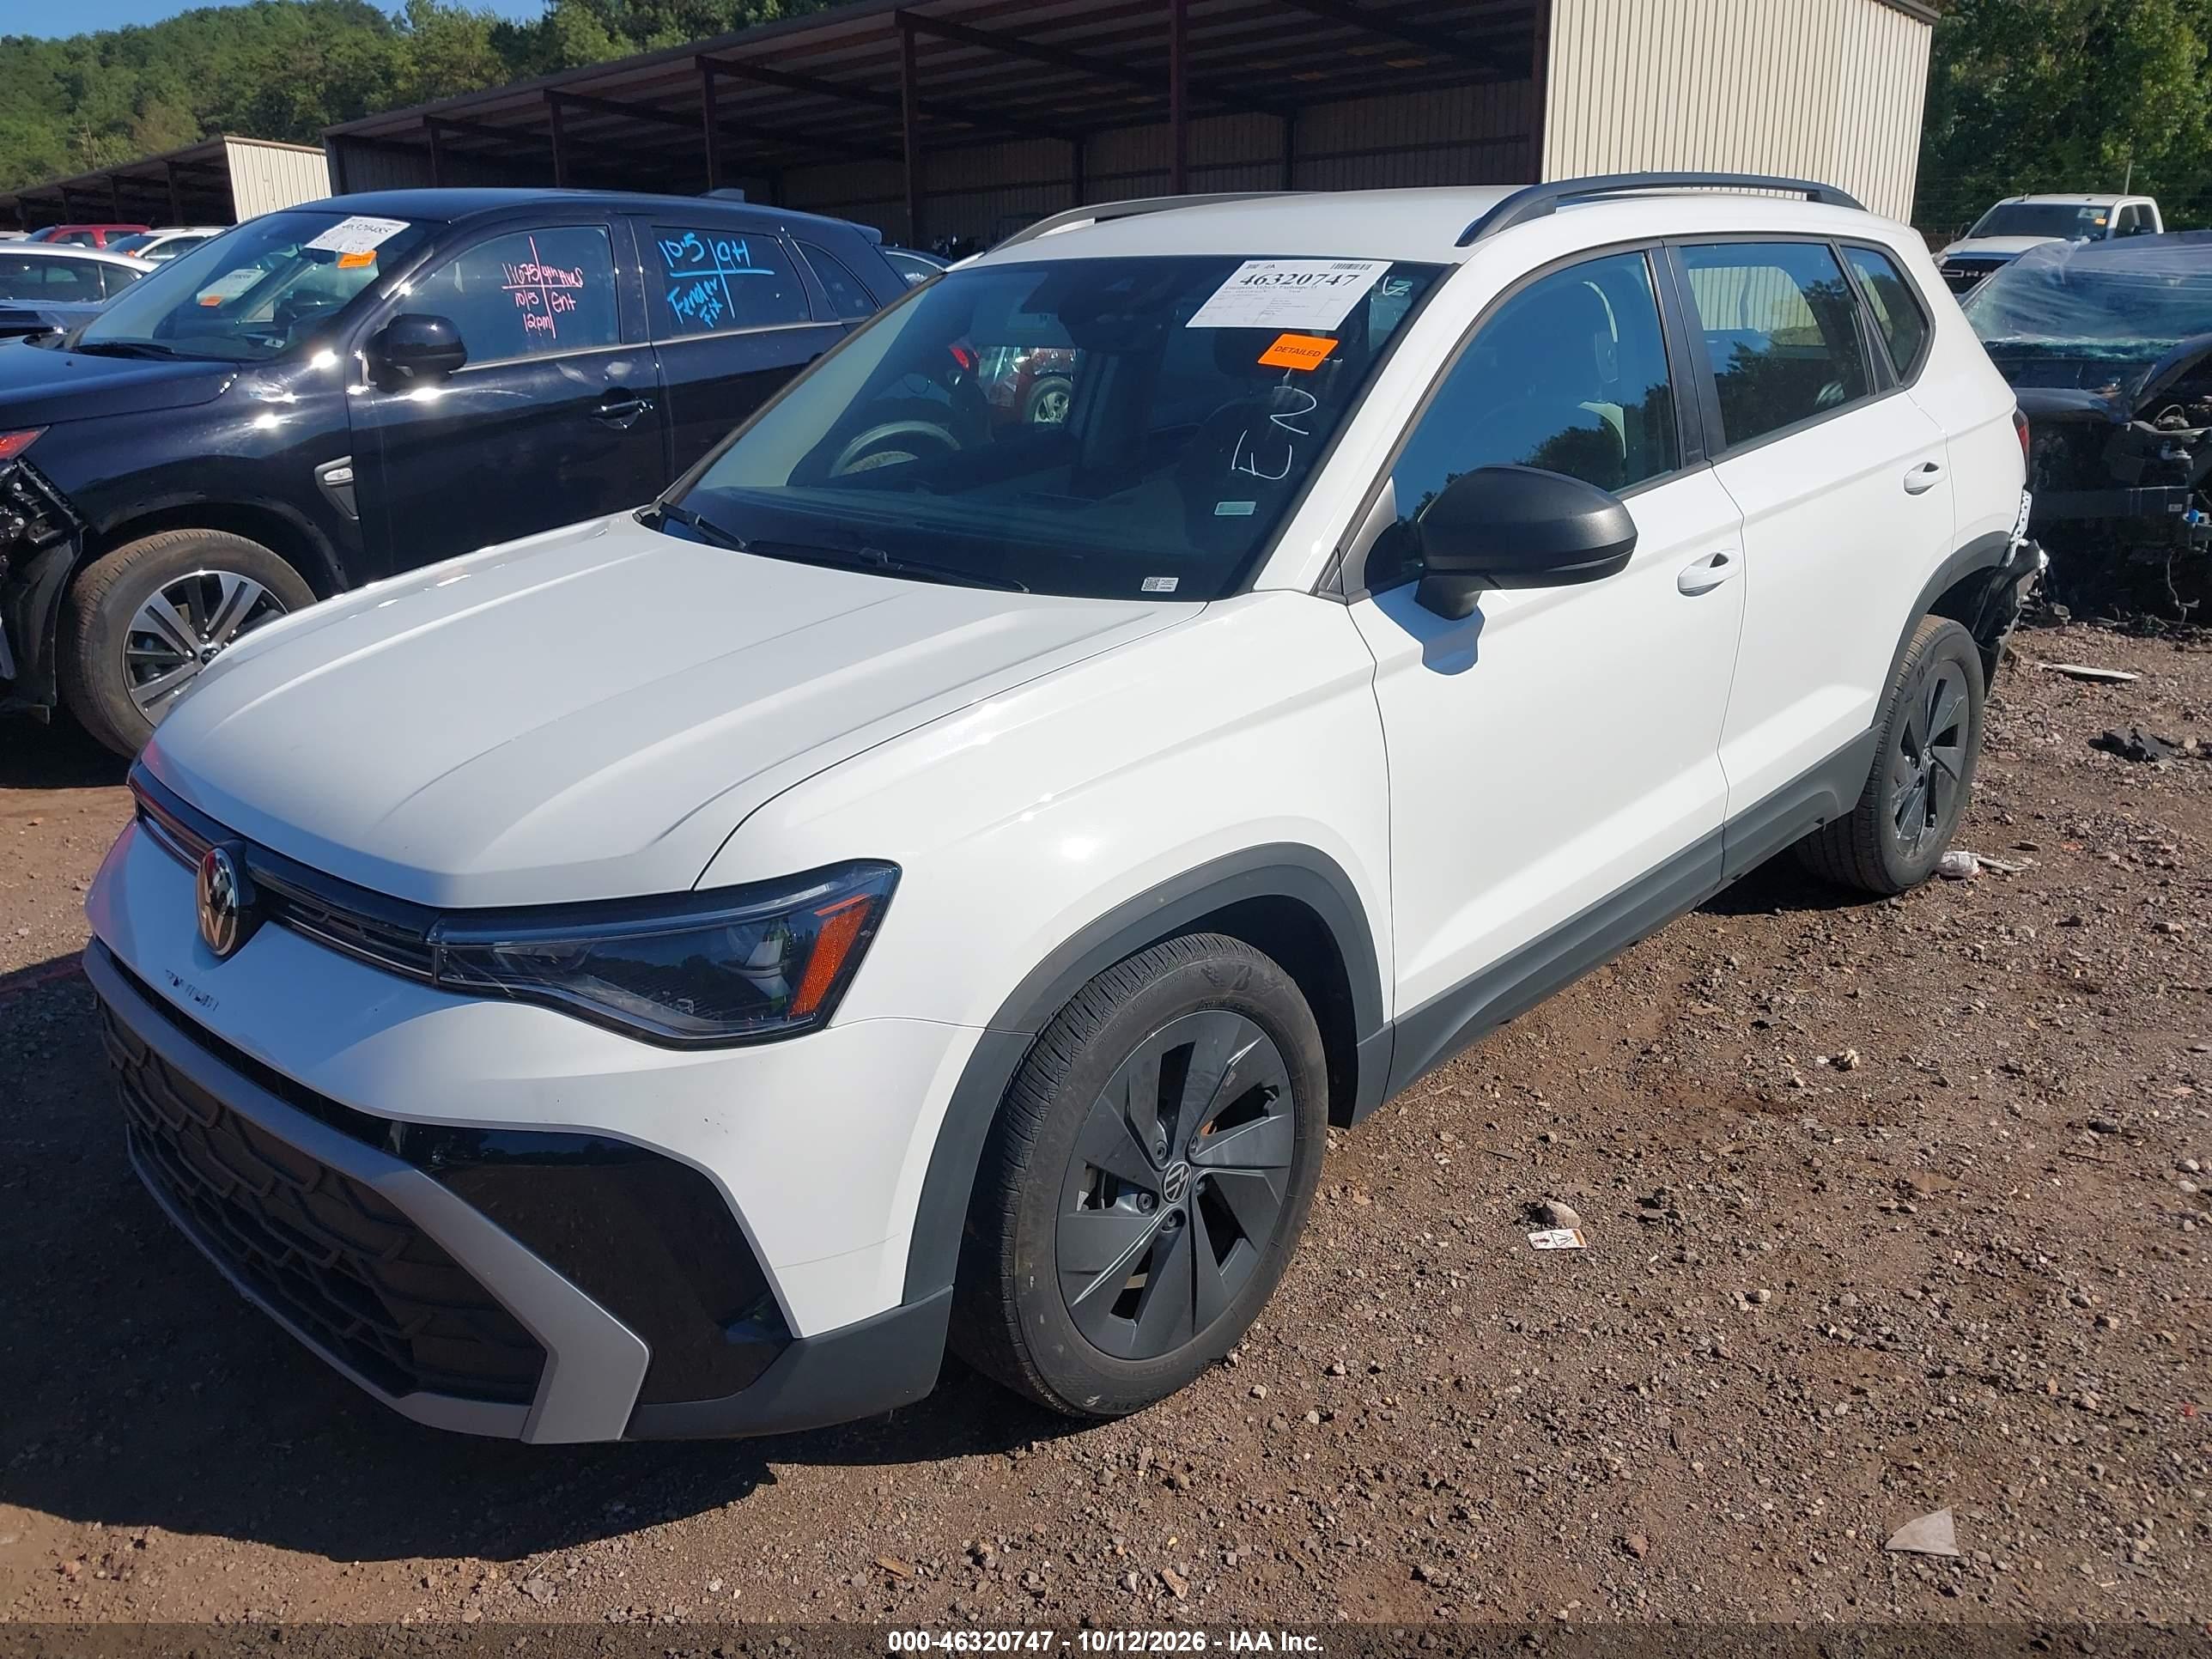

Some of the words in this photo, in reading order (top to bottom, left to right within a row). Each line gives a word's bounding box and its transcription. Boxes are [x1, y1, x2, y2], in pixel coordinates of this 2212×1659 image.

[1239, 273, 1361, 286] 46320747
[523, 313, 552, 333] 12pm
[1274, 345, 1322, 357] DETAILED
